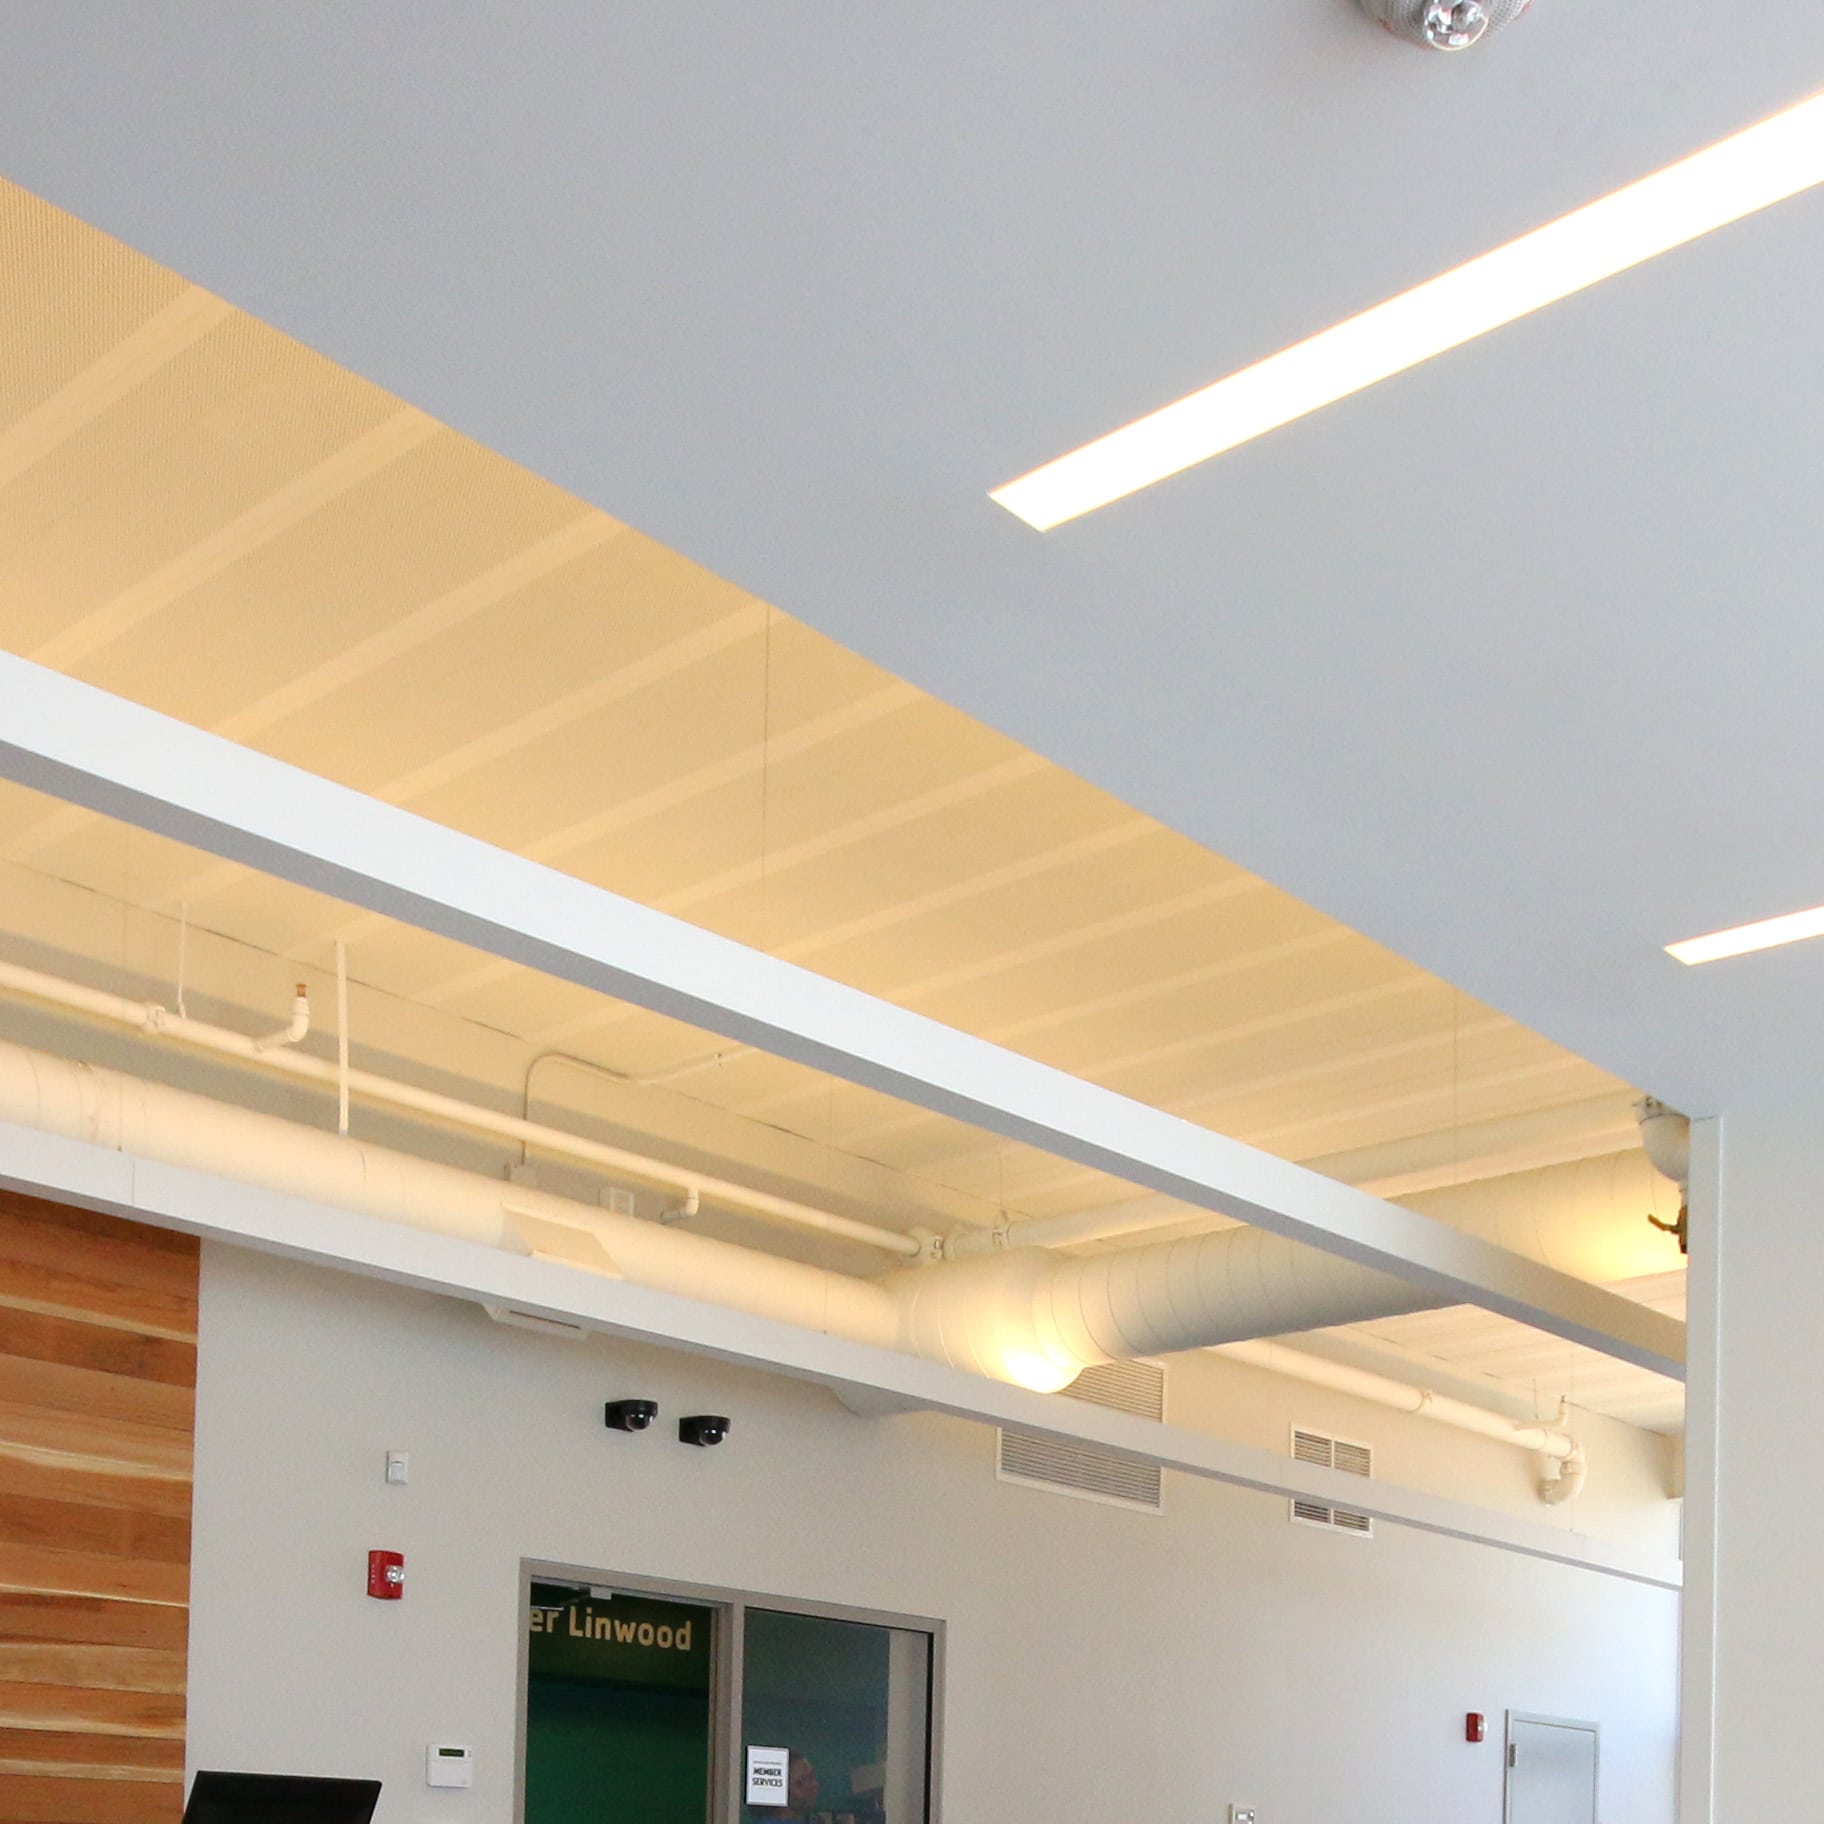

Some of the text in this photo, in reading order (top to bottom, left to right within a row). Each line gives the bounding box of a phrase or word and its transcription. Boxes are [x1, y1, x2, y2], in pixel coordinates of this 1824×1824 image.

[569, 1605, 691, 1651] Linwood
[753, 1767, 782, 1776] MEMBER
[752, 1777, 783, 1787] SERVICES
